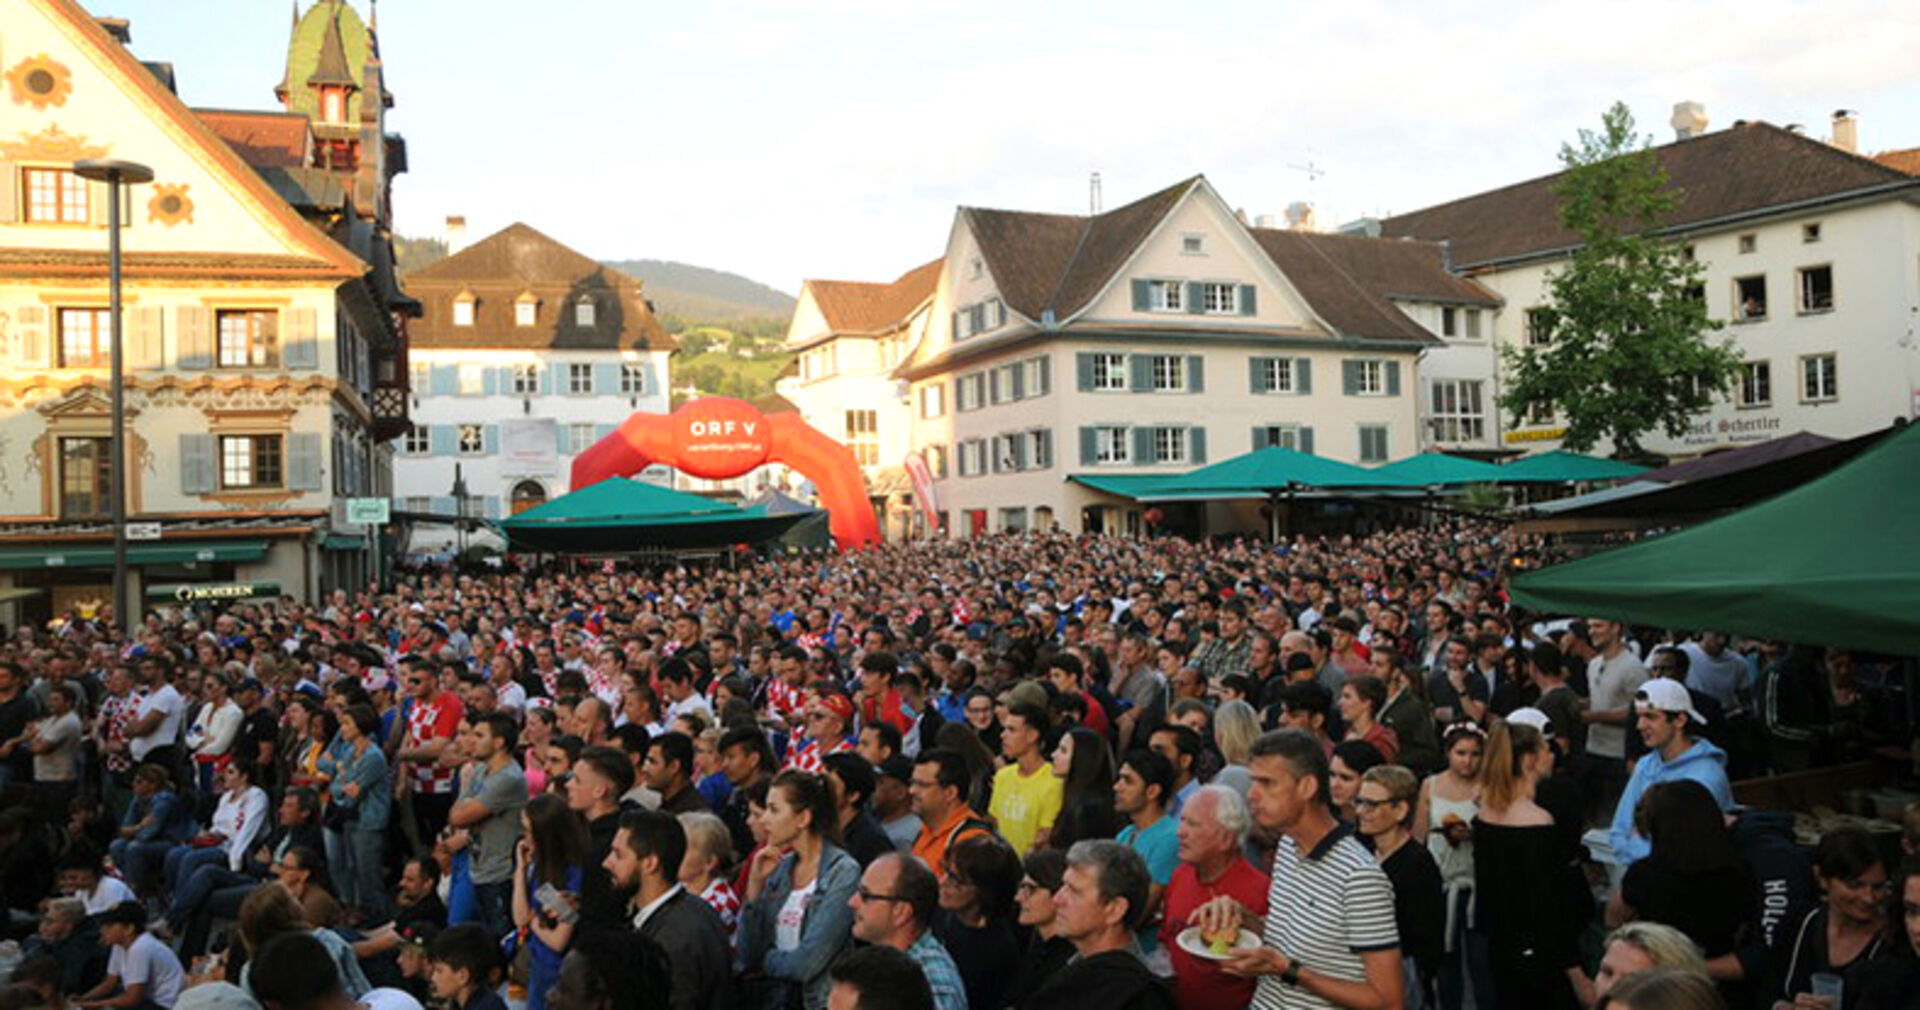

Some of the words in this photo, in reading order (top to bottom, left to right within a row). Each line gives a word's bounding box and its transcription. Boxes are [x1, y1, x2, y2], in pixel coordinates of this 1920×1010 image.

[690, 420, 735, 436] ORF
[742, 420, 756, 436] V
[129, 526, 148, 537] WC
